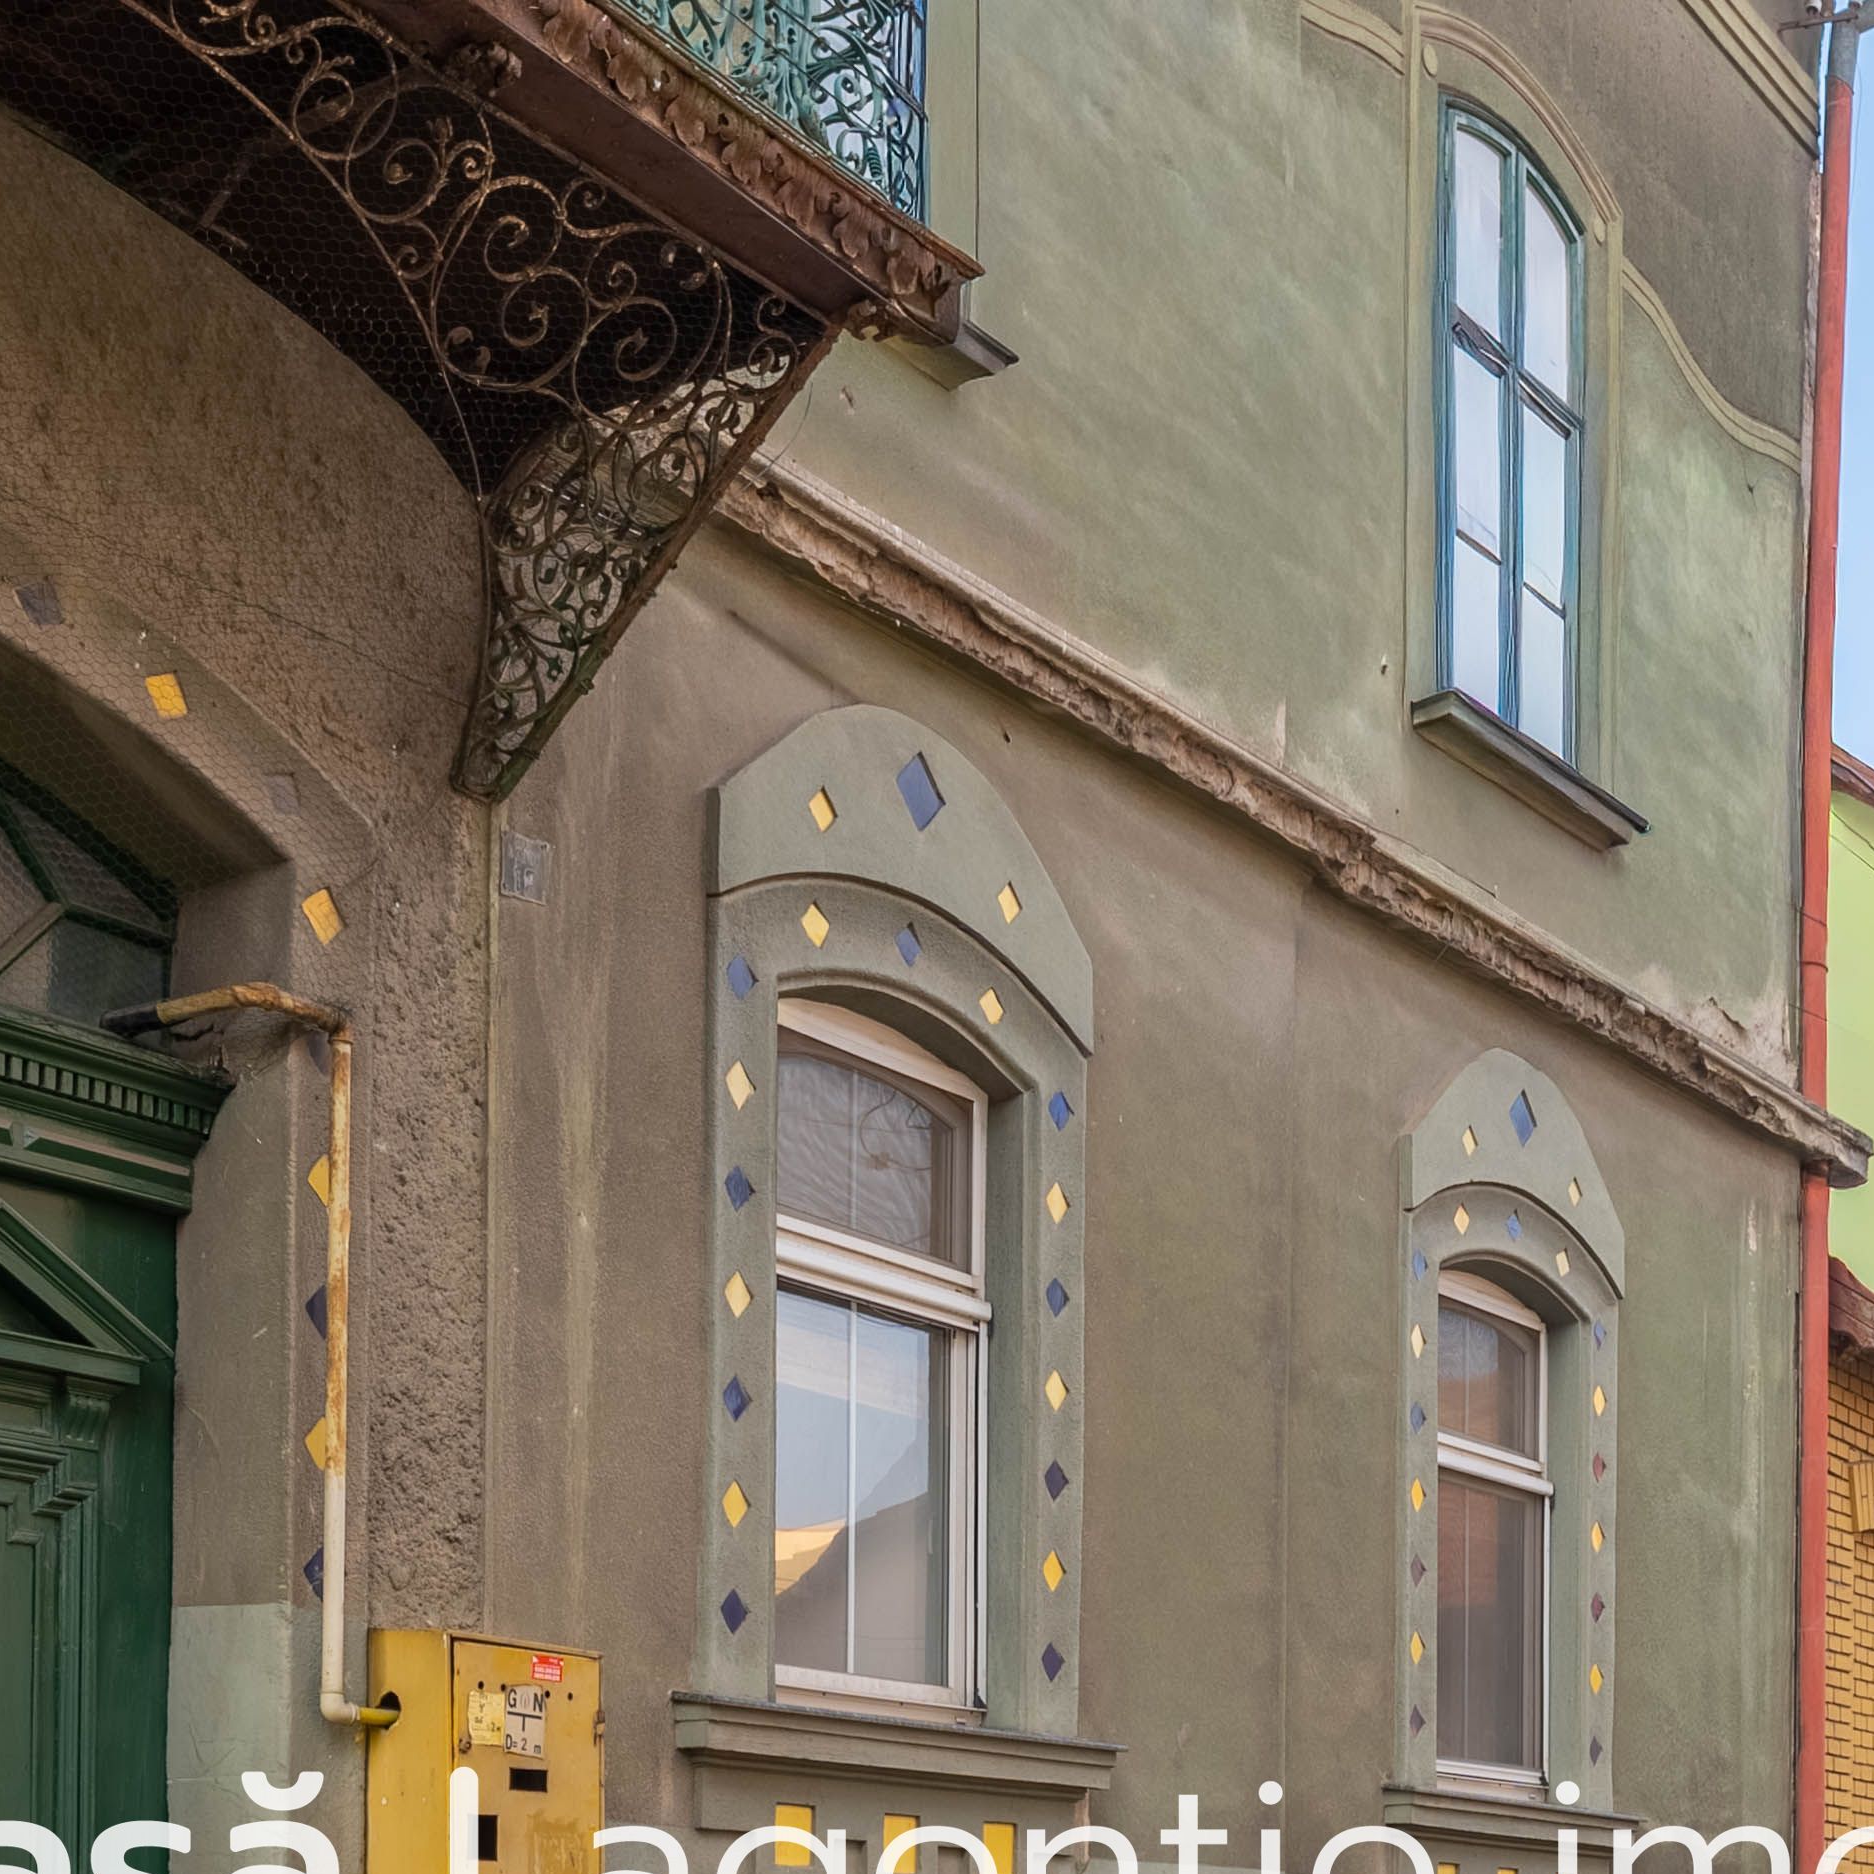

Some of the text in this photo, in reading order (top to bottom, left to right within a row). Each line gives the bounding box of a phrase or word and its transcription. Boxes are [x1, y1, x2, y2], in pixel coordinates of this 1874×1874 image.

[507, 1688, 545, 1713] G N
[521, 1737, 528, 1752] 2
